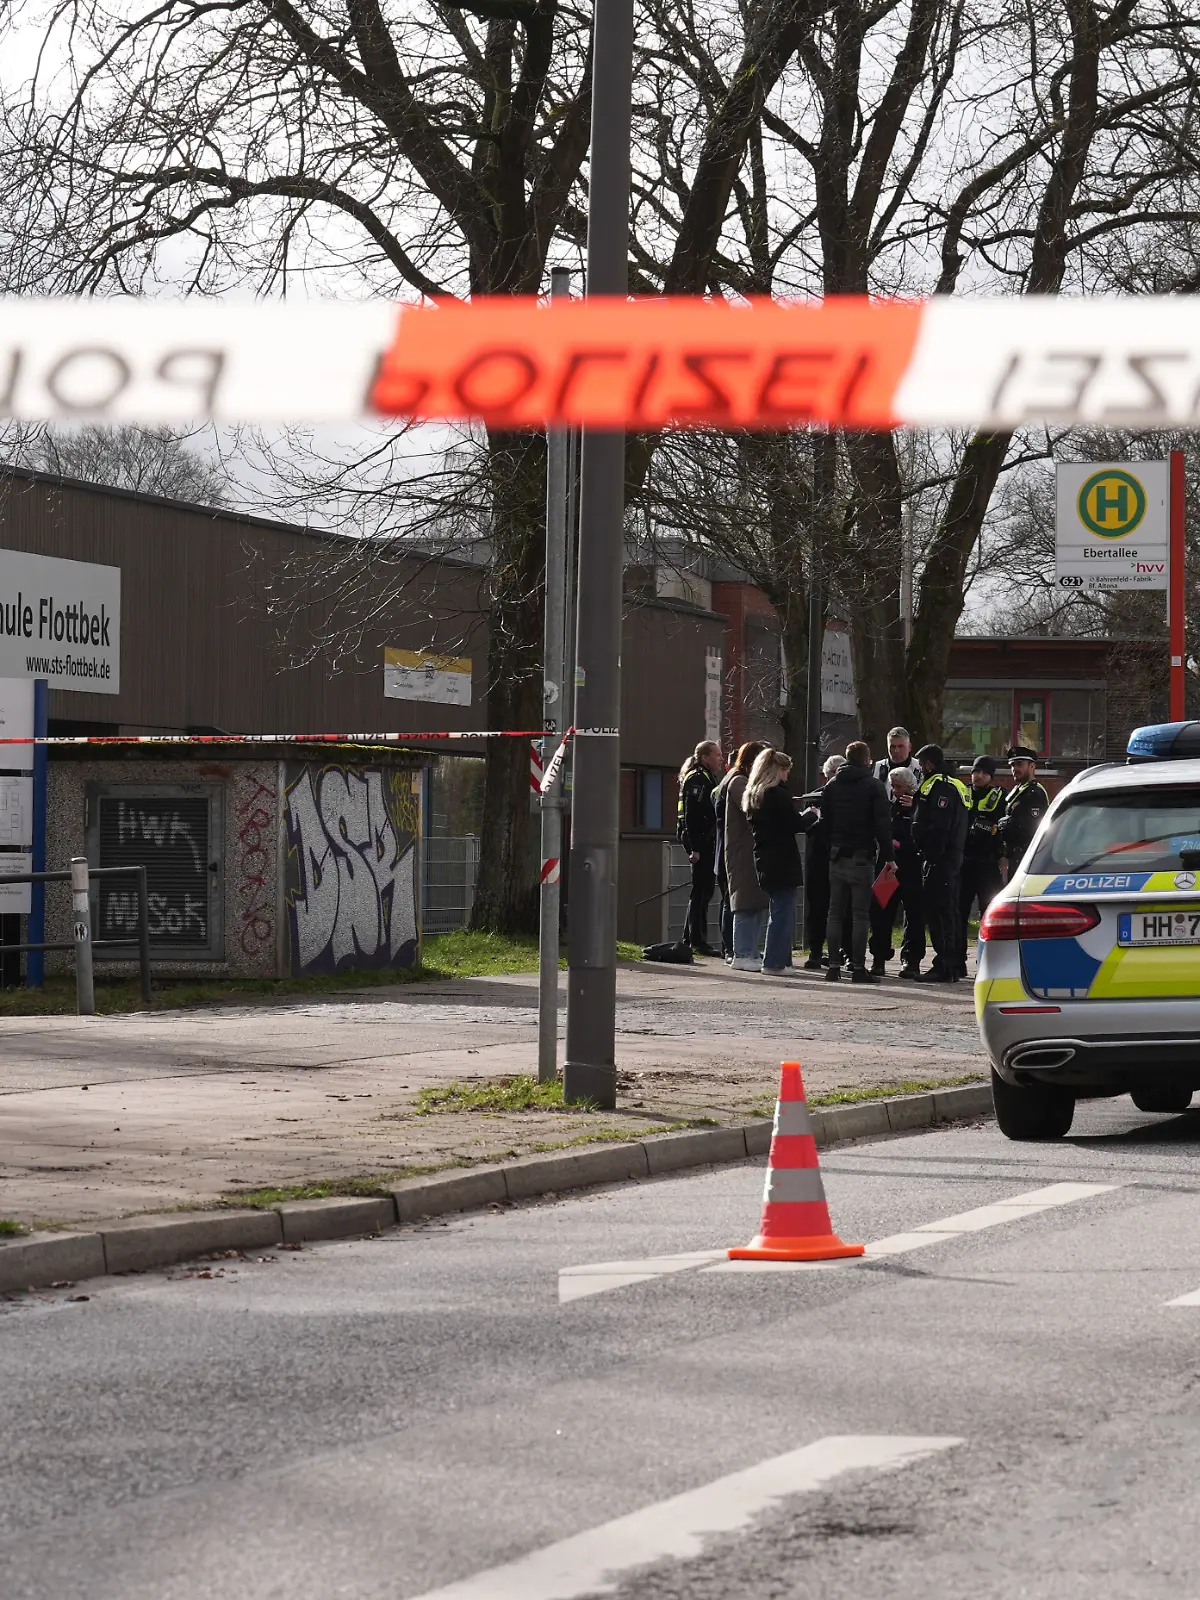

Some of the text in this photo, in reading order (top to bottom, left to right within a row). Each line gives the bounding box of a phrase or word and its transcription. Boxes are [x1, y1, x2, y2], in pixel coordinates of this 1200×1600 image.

[1096, 485, 1128, 522] H
[1083, 548, 1138, 558] Ebertallee
[1136, 562, 1165, 573] hvv
[1062, 576, 1081, 586] 621
[39, 596, 110, 647] Flottbek
[26, 654, 110, 679] www.sts-flottbek.de
[1064, 875, 1130, 891] POLIZEI
[1143, 916, 1172, 938] HH
